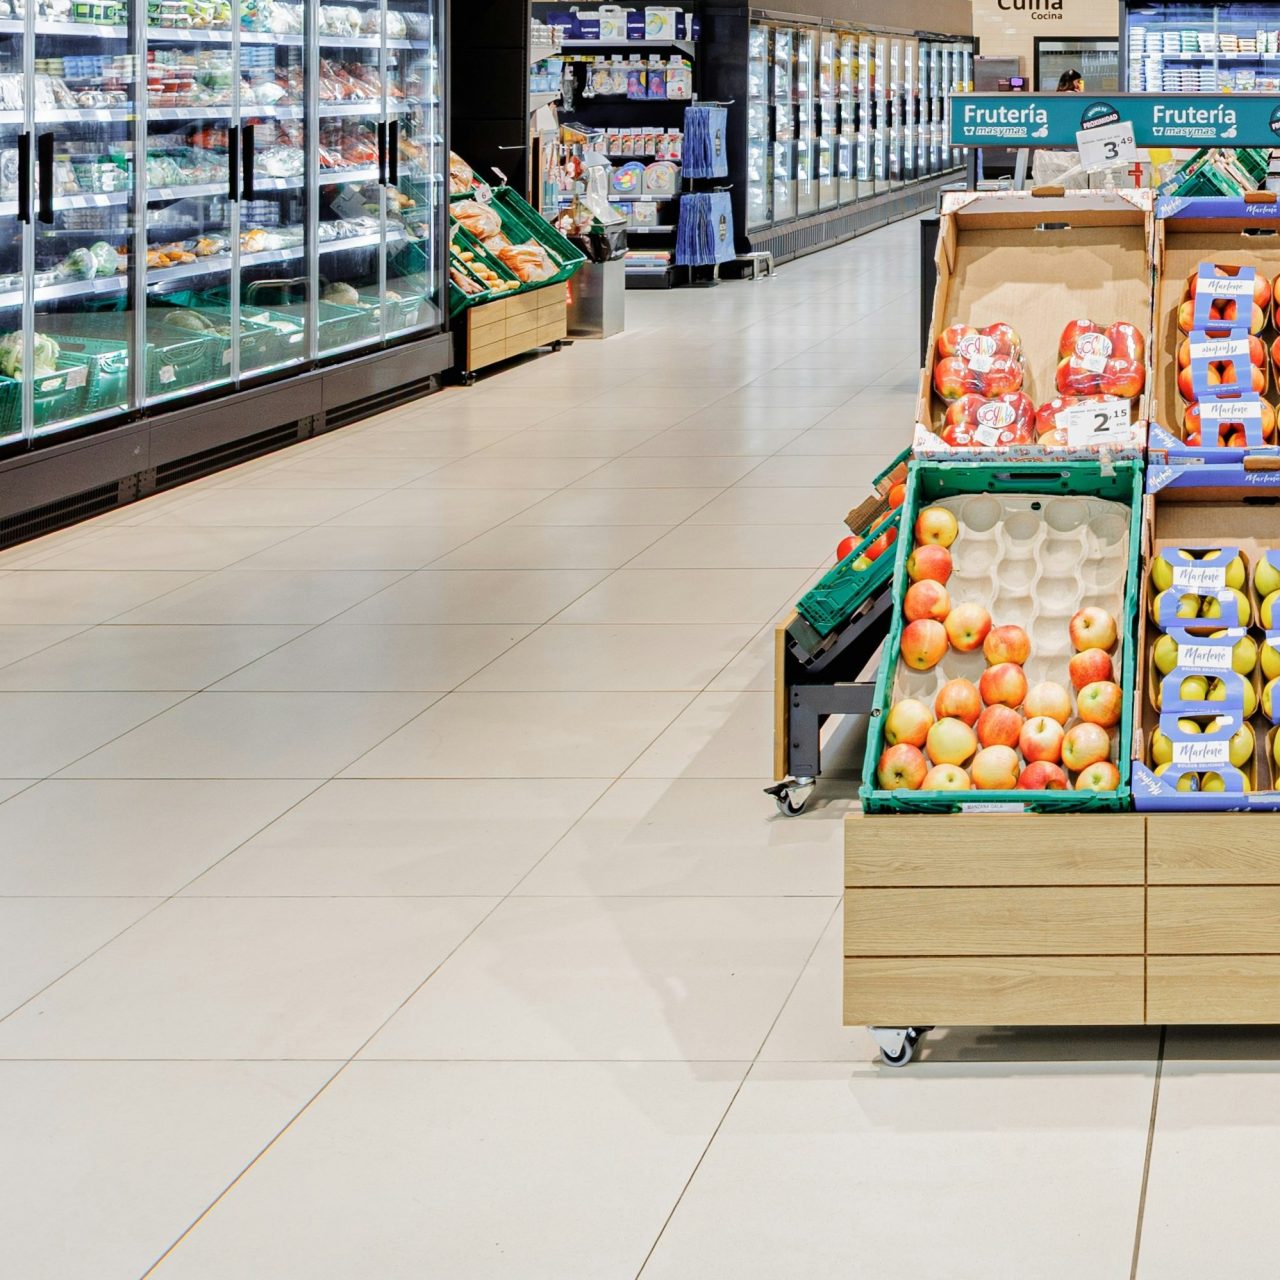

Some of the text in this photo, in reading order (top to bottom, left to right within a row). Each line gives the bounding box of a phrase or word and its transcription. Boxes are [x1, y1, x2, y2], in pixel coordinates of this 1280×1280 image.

[1031, 11, 1063, 20] Cocina
[964, 103, 1048, 124] Frutería
[1082, 113, 1119, 130] PROXIMIDAD
[1153, 103, 1237, 124] Frutería
[975, 126, 1028, 138] masymas
[1164, 126, 1217, 138] masymas
[1246, 204, 1278, 215] Marlene
[1207, 278, 1244, 294] Marlene
[1211, 403, 1248, 419] Marlene
[1094, 408, 1127, 433] 2,15
[1245, 472, 1280, 484] Marlene
[1179, 567, 1220, 586] Marlene
[1184, 646, 1226, 665] Marlene
[1180, 742, 1223, 761] Marlene
